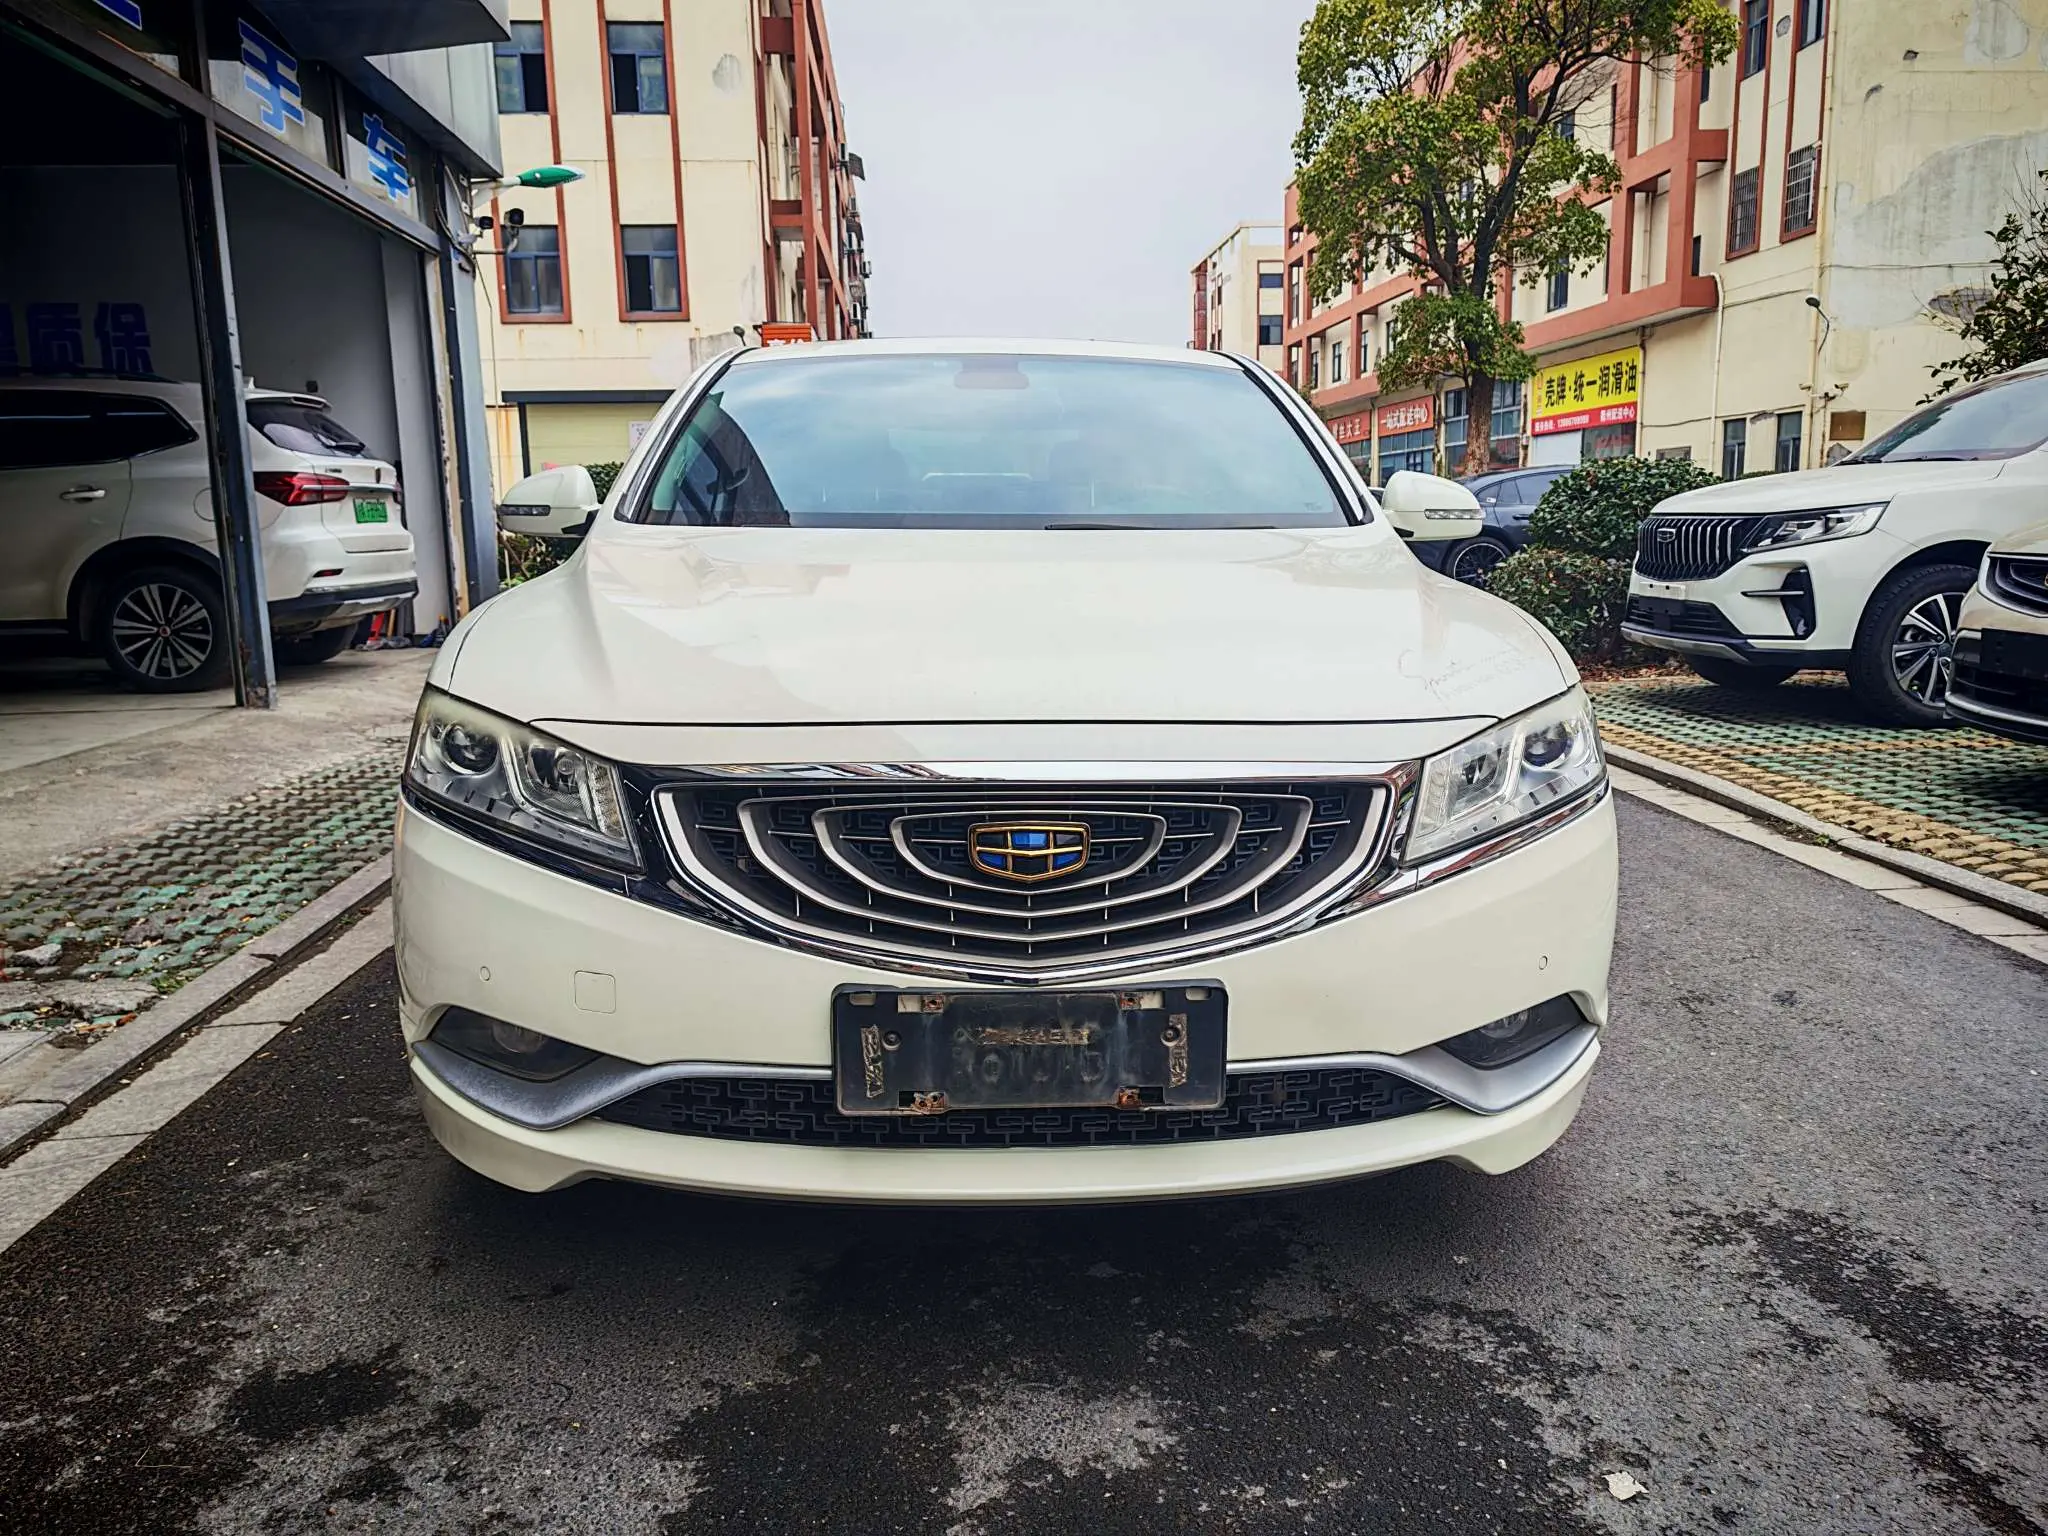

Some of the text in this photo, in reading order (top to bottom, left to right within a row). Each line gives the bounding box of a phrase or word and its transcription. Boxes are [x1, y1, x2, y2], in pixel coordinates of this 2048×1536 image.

[1380, 402, 1428, 431] 一站式配送中心
